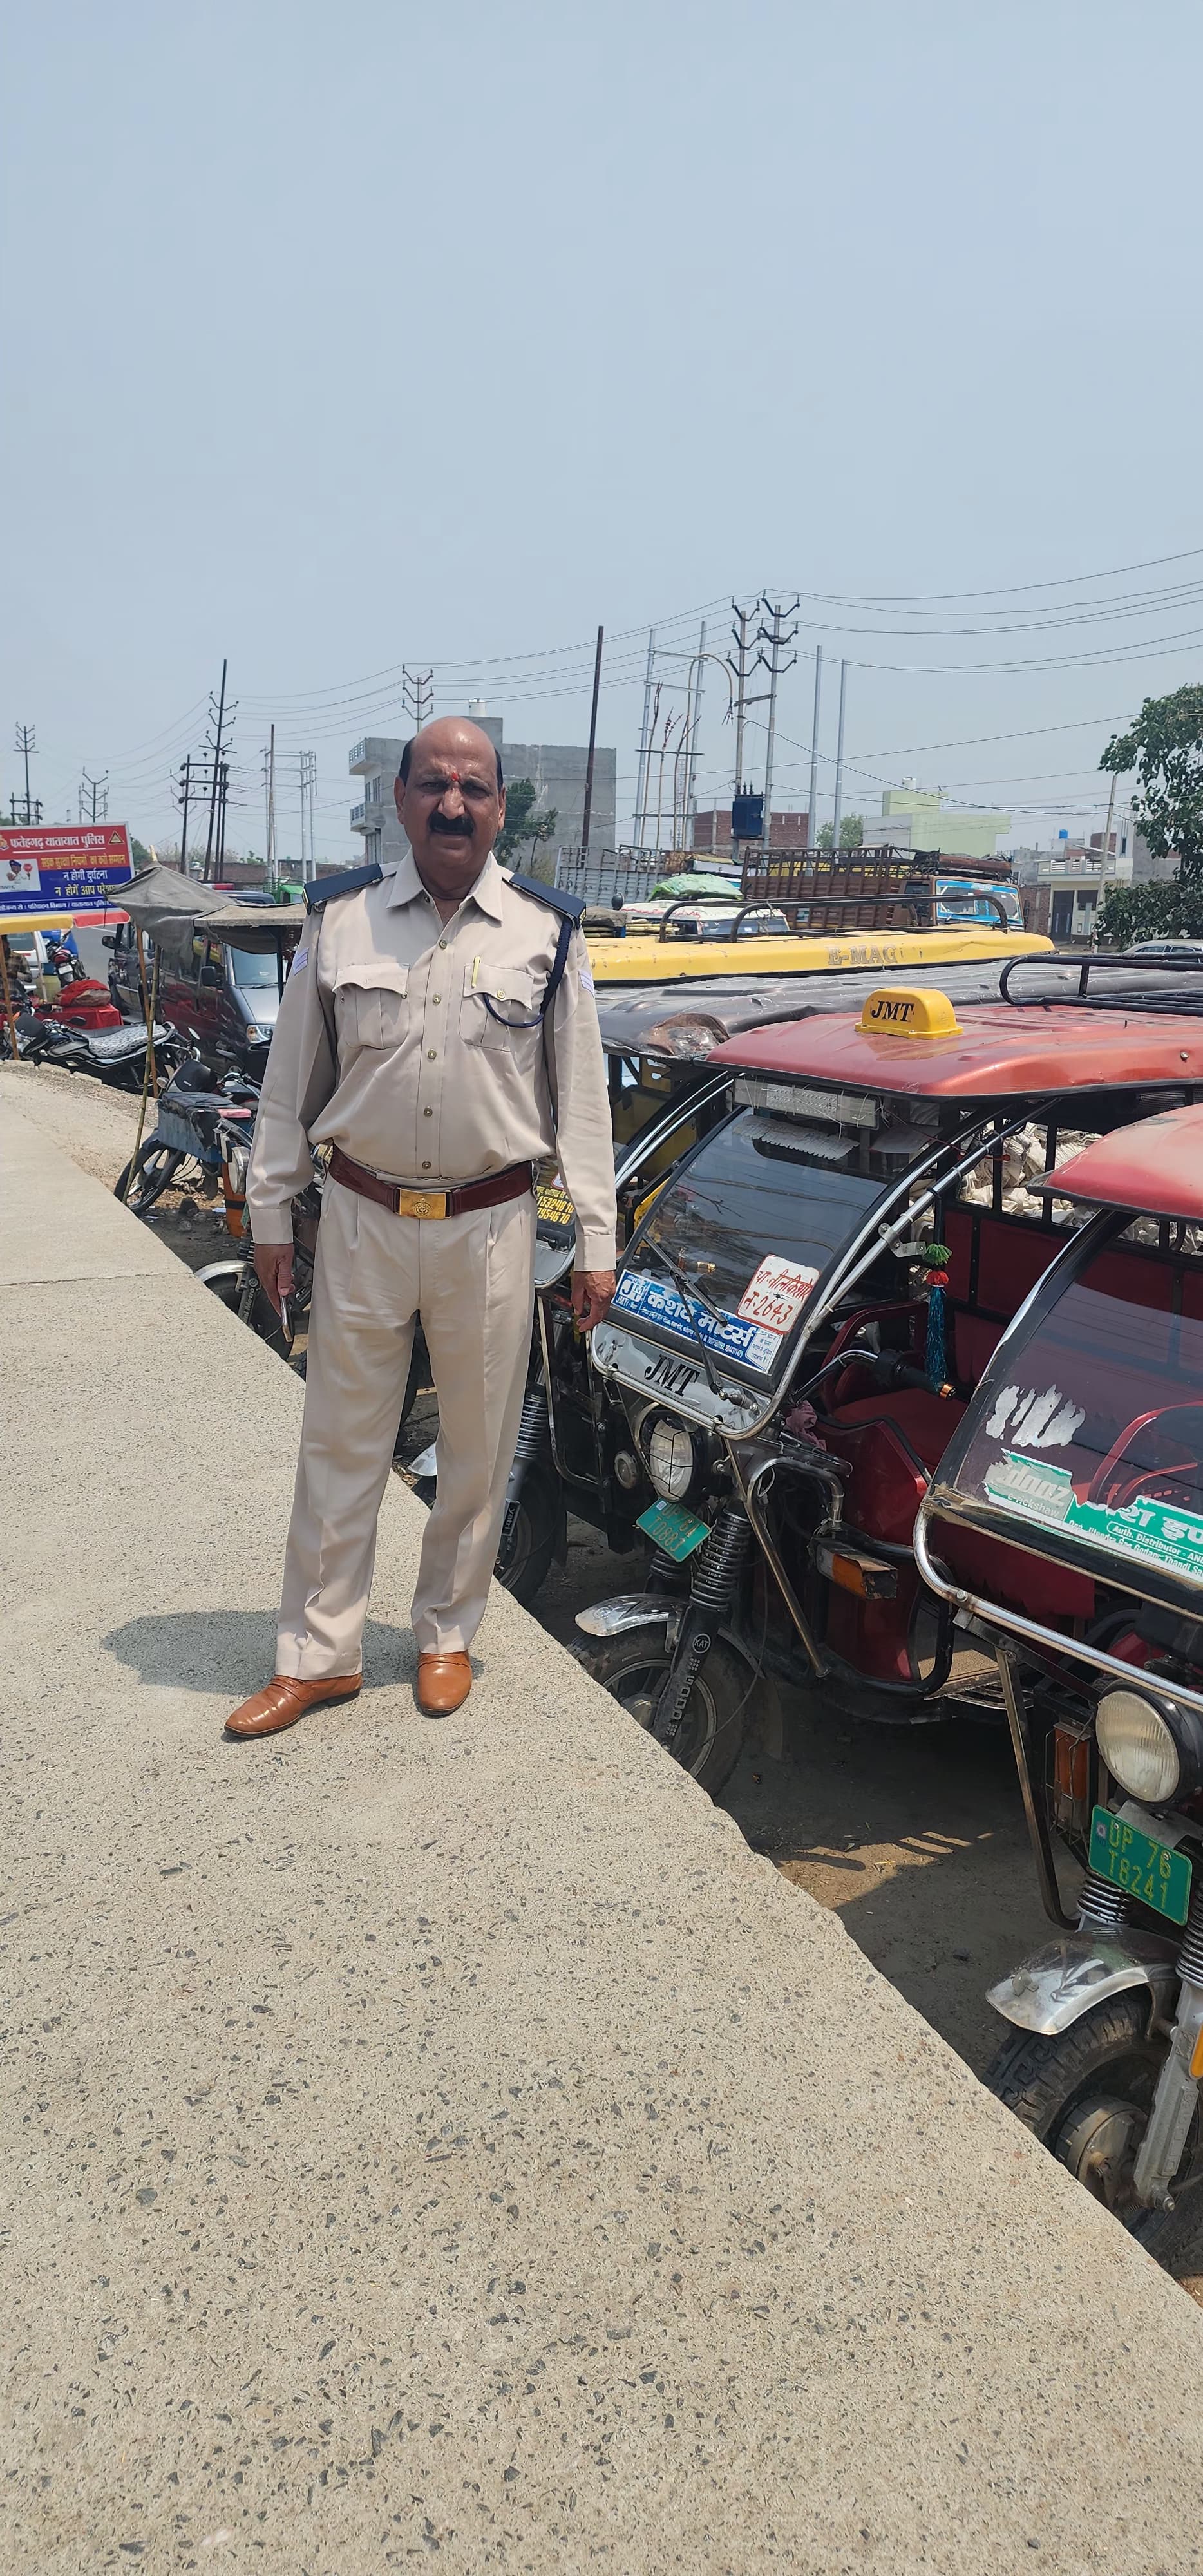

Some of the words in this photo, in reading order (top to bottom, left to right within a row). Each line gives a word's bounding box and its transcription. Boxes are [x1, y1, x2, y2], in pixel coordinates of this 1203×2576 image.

[10, 835, 44, 849] फतेहगढ़
[45, 837, 79, 846] यातायात
[81, 832, 105, 848] पुलिस
[62, 871, 70, 881] न
[70, 868, 85, 881] होगी
[86, 867, 108, 883] दुर्घटना
[54, 887, 62, 896] न
[81, 885, 95, 895] आप
[871, 1000, 914, 1022] JMT
[644, 1354, 701, 1397] JMT
[1112, 1525, 1134, 1539] Auth.
[1135, 1533, 1182, 1555] Distributor
[694, 1639, 709, 1649] KAT
[1108, 1819, 1133, 1853] UP
[1146, 1839, 1172, 1880] 76
[1108, 1848, 1168, 1910] T8241
